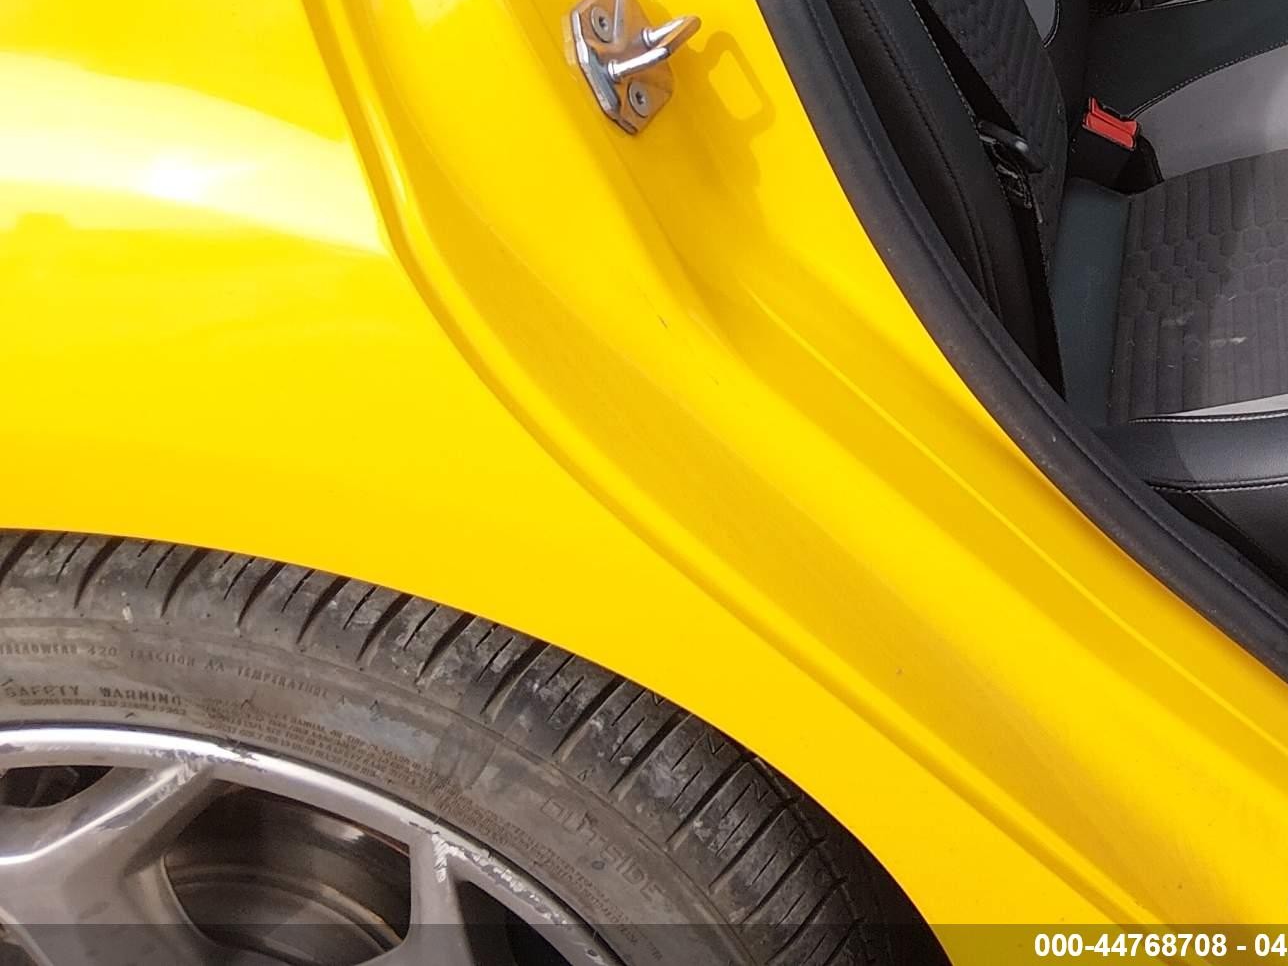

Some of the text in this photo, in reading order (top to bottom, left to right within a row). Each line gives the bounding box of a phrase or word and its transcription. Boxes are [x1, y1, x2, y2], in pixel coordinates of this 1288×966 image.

[4, 684, 183, 706] SAFETY WARNING
[540, 797, 668, 904] OUTSIDE
